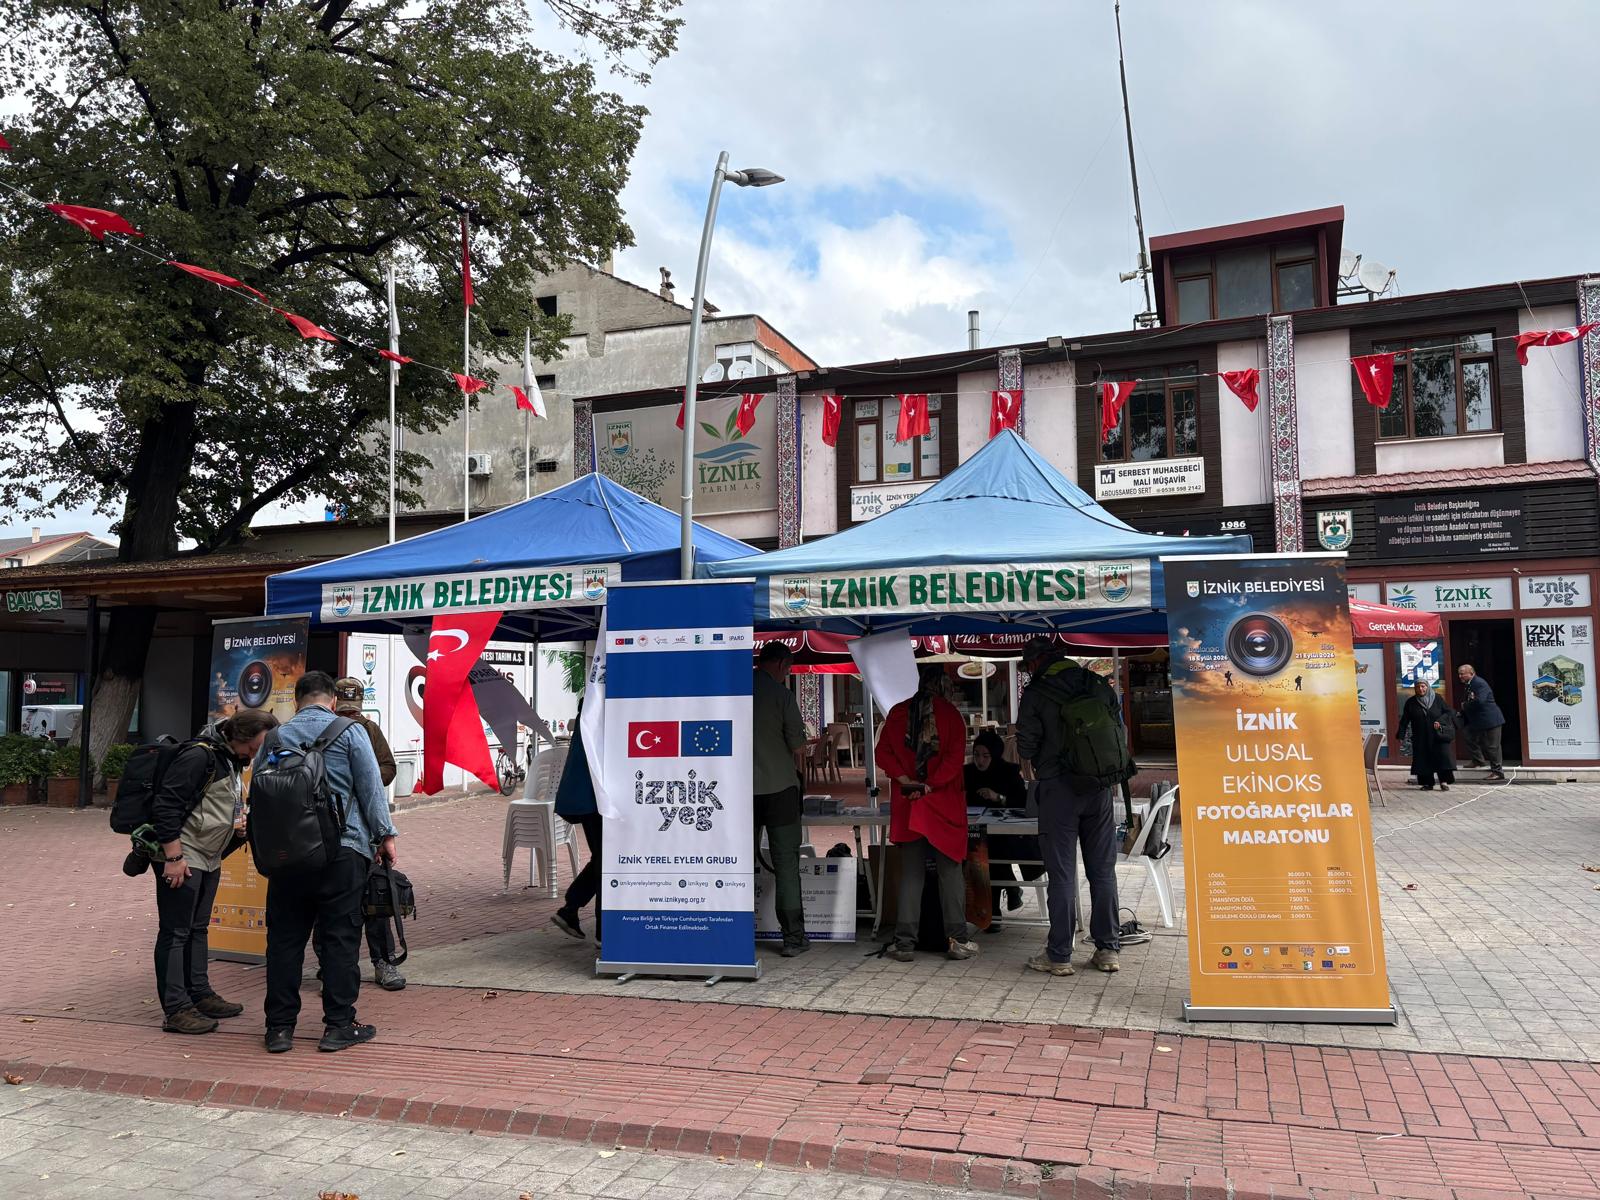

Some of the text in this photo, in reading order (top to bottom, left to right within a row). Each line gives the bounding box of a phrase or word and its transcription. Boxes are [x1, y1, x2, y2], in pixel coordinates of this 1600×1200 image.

[699, 459, 761, 484] İZNİK
[1118, 463, 1201, 478] SERBEST MUHASEBECİ
[1133, 475, 1186, 486] MALİ MÜŞAVİR
[701, 484, 736, 493] TARIM
[1138, 487, 1151, 495] SERT
[852, 491, 883, 506] iznik
[861, 505, 882, 516] yeg
[1221, 520, 1246, 529] 1986
[1203, 577, 1325, 594] İZNİK BELEDİYESİ
[1435, 584, 1493, 602] İZNİK
[1527, 577, 1580, 596] iznik
[1543, 593, 1575, 607] yeg
[1368, 622, 1424, 633] Gerçek Mucize
[232, 632, 297, 648] İZNİK BELEDİYESİ
[1236, 707, 1299, 731] İZNİK
[1226, 743, 1313, 762] ULUSAL
[1222, 771, 1322, 793] EKİNOKS
[634, 769, 725, 811] iznik
[658, 806, 715, 832] yeg
[1197, 801, 1354, 823] FOTOĞRAFÇILAR
[1223, 829, 1330, 845] MARATONU
[618, 854, 738, 865] İZNİK YEREL EYLEM GRUBU
[687, 879, 708, 888] iznikyeg
[725, 880, 746, 888] iznikyeg
[649, 896, 706, 905] www.iznikyeg.org.tr
[622, 915, 639, 923] Avrupa
[661, 915, 678, 923] Türkiye
